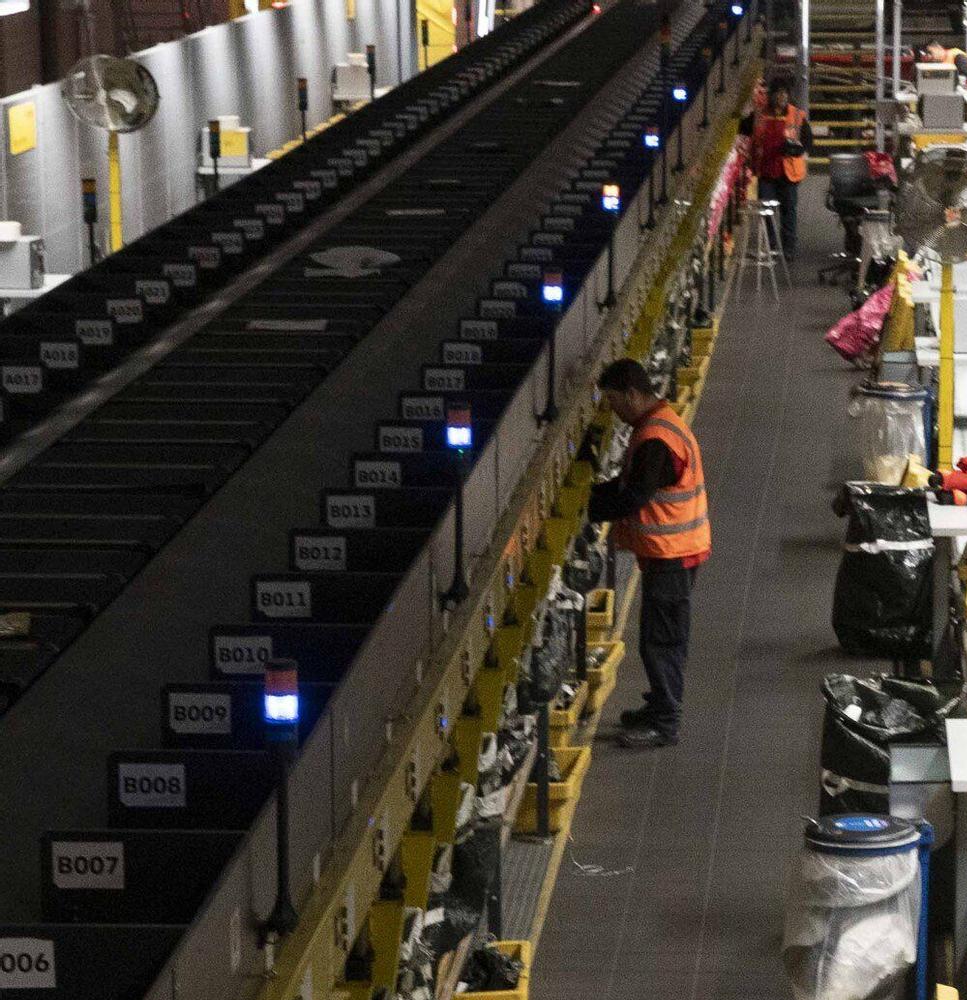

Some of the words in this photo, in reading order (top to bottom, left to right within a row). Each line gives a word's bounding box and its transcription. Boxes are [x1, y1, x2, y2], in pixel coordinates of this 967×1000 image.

[330, 504, 371, 518] B013
[299, 545, 342, 560] B012
[260, 592, 307, 608] B011
[218, 647, 269, 663] B010
[173, 705, 227, 722] B009
[123, 776, 182, 795] B008
[58, 856, 119, 875] B007
